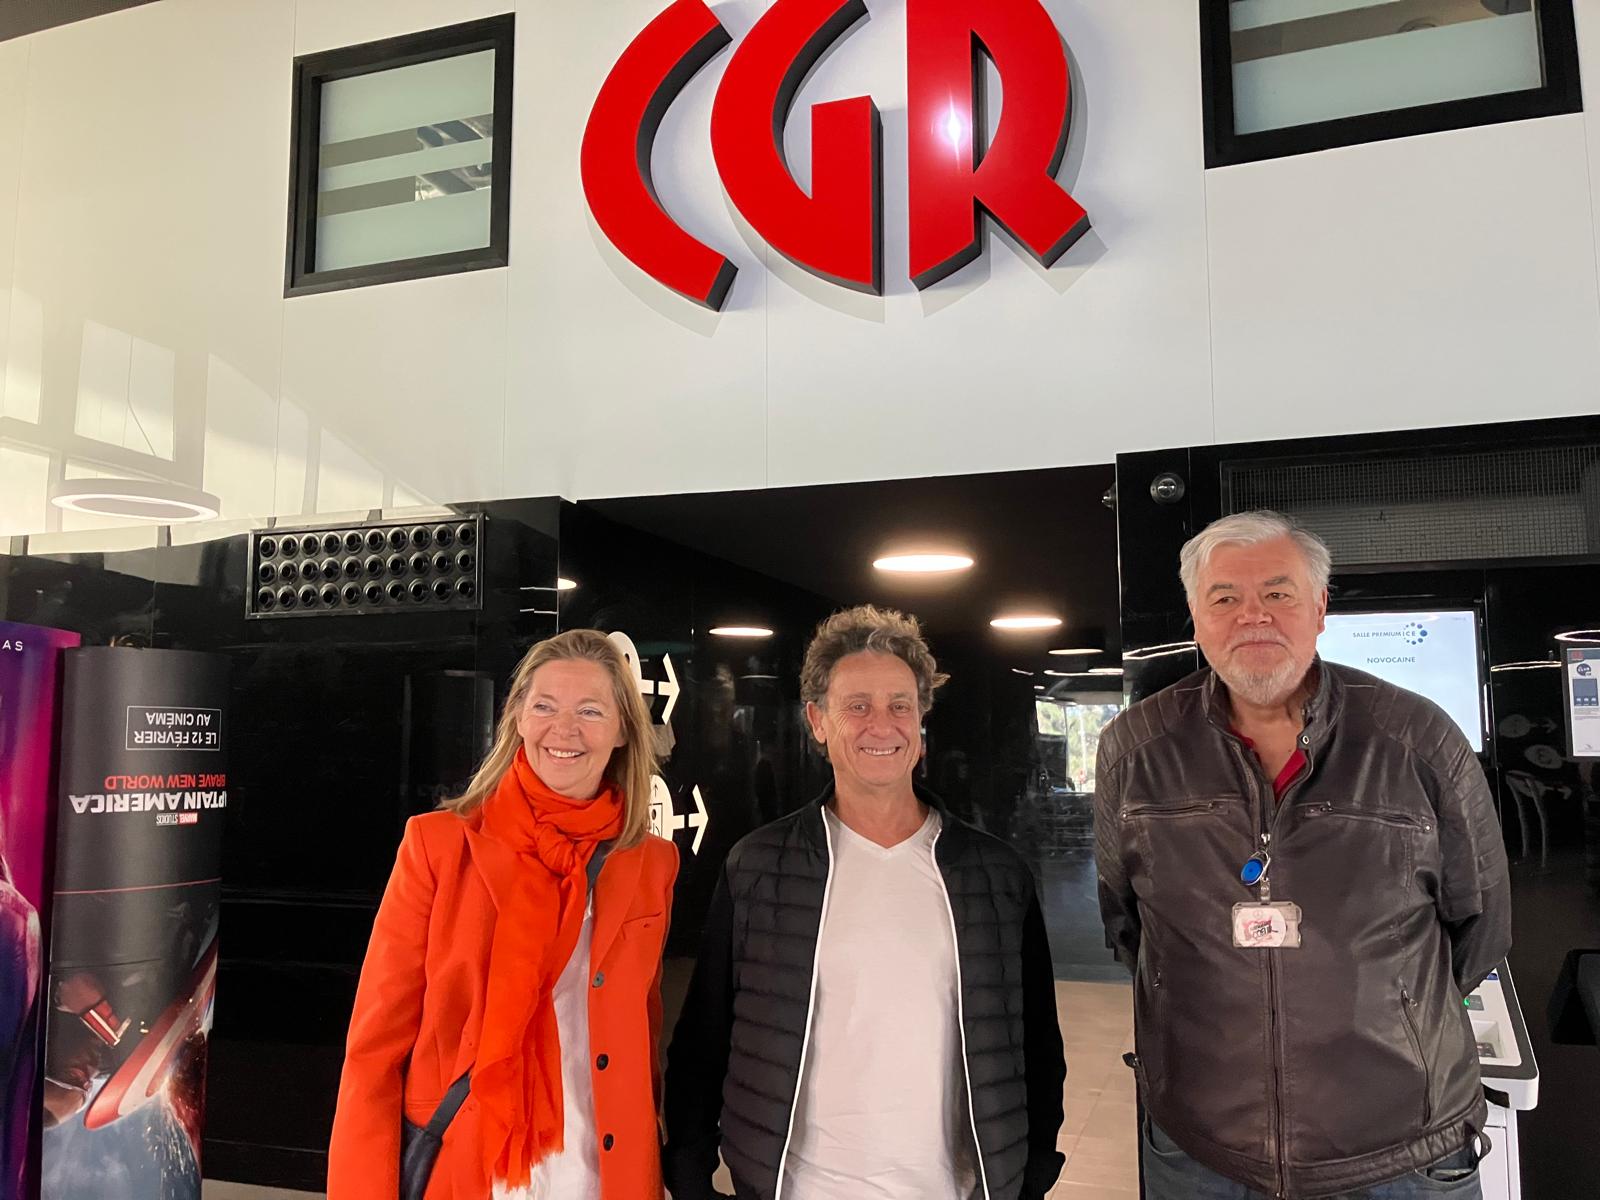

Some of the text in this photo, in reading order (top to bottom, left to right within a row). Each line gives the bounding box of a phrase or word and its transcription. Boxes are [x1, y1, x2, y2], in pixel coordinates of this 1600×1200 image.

[580, 0, 1091, 312] CGR
[1366, 656, 1416, 664] NOVOCAINE
[145, 712, 212, 729] AU CINÉMA
[134, 730, 217, 748] LE 12 FÉVRIER
[104, 774, 165, 790] WORLD
[166, 774, 196, 789] NEW
[68, 790, 227, 814] PTAIN AMERICA
[156, 813, 198, 826] MARVEL STUDIOS
